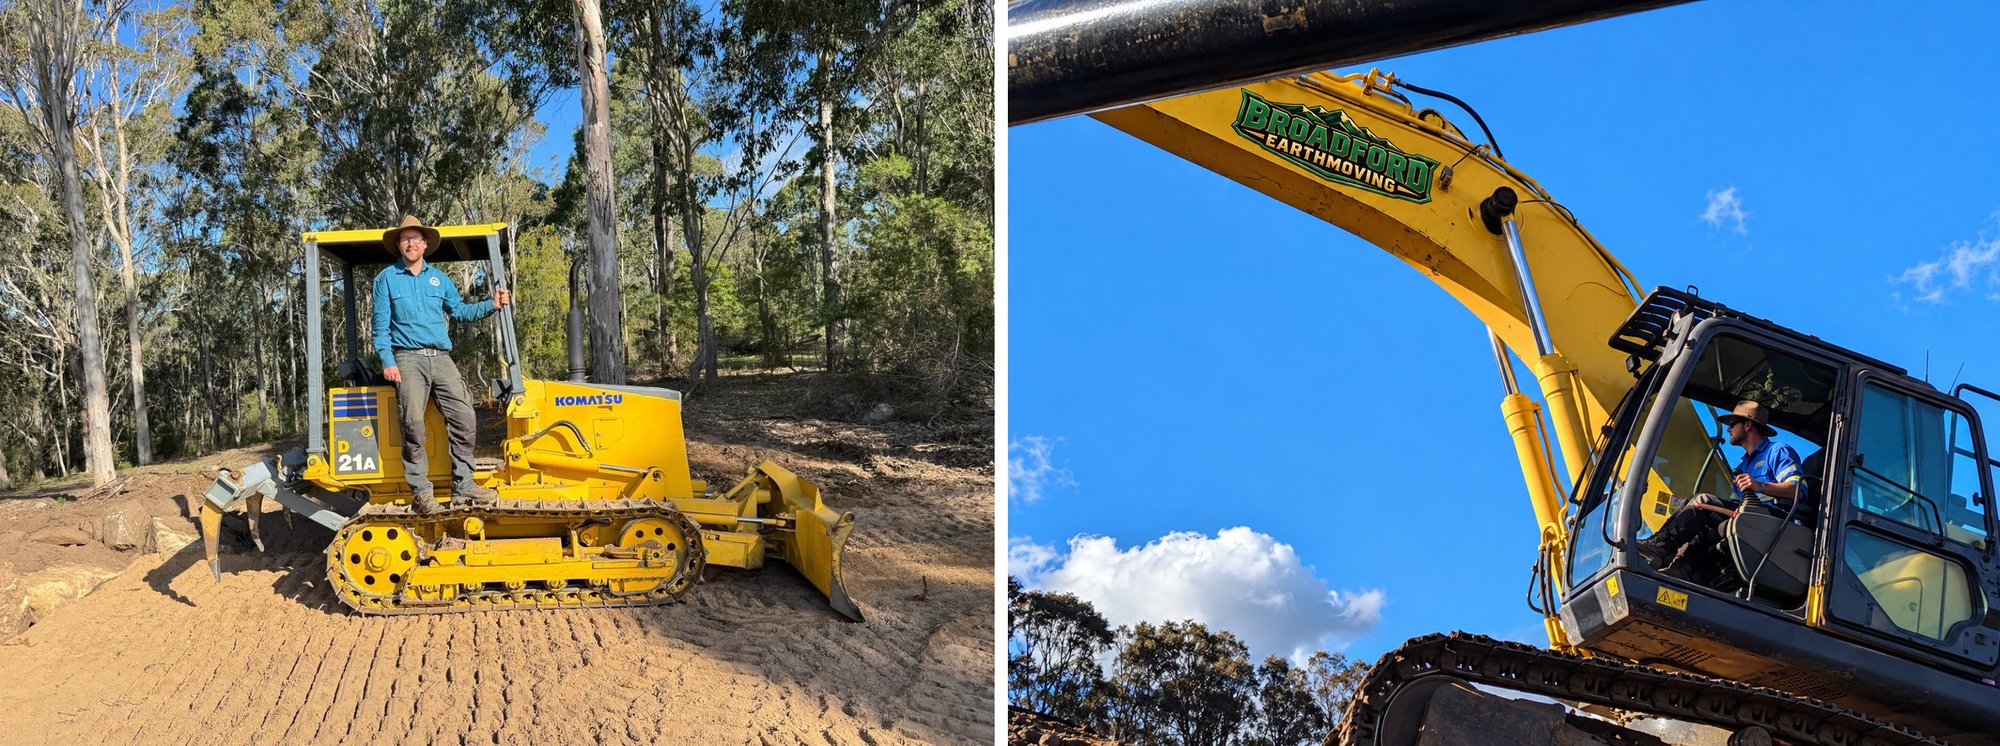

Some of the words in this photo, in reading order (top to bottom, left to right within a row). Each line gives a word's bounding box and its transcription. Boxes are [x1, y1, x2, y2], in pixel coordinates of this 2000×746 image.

[1243, 96, 1429, 194] BROADFORD
[1265, 133, 1396, 193] EARTHMOVING
[555, 394, 623, 406] KOMATSU
[337, 440, 350, 454] D
[338, 453, 376, 472] 21A
